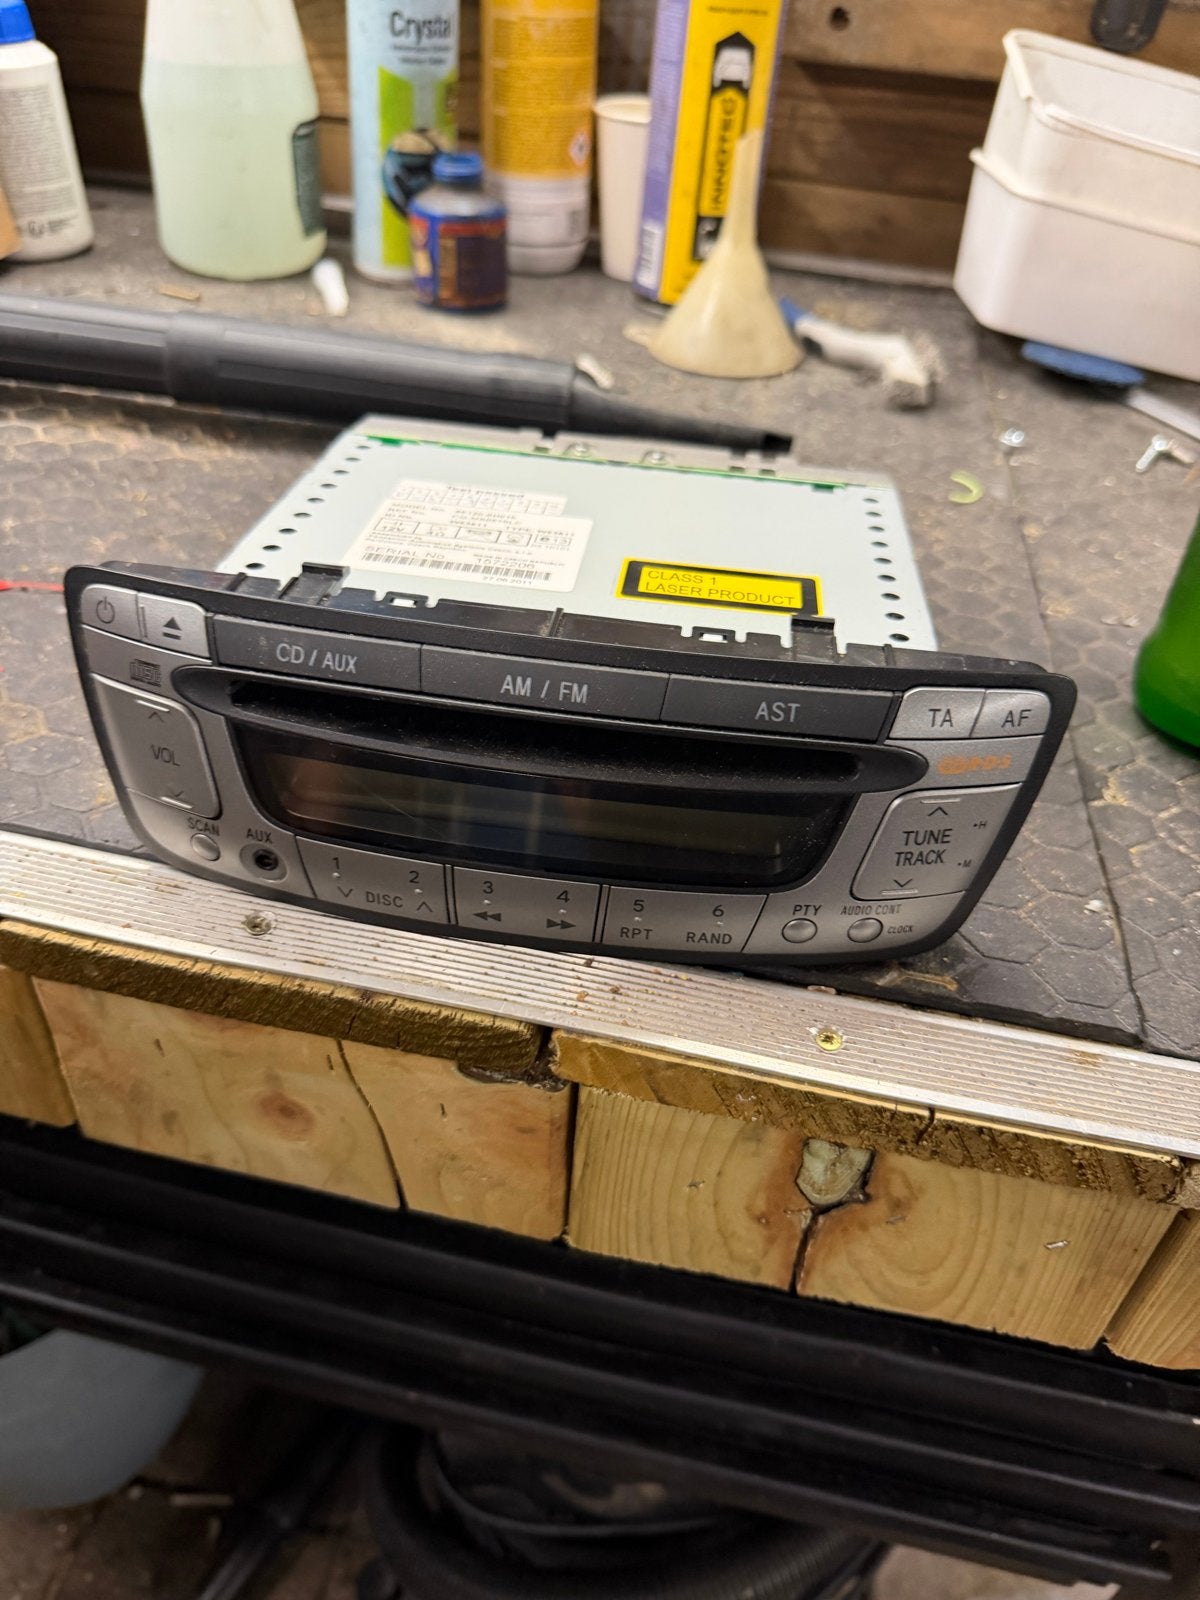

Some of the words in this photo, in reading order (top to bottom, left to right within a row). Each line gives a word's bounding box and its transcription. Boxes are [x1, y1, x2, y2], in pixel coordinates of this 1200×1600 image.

[647, 569, 704, 584] CLASS
[711, 576, 717, 586] 1
[645, 582, 702, 597] LASER
[707, 588, 796, 606] PRODUCT
[275, 643, 305, 665] CD
[321, 649, 358, 675] AUX
[500, 674, 532, 697] AM
[558, 681, 589, 704] FM
[754, 701, 801, 723] AST
[928, 708, 954, 728] TA
[1001, 708, 1032, 729] AF
[150, 743, 181, 767] VOL
[187, 816, 220, 837] SCAN
[246, 826, 274, 845] AUX
[902, 828, 953, 847] TUNE
[332, 856, 340, 870] 1
[894, 848, 947, 868] TRACK
[408, 870, 419, 884] 2
[482, 880, 494, 895] 3
[556, 889, 570, 904] 4
[365, 890, 404, 909] DISC
[632, 899, 645, 913] 5
[712, 904, 725, 918] 6
[792, 904, 822, 917] PTY
[840, 904, 872, 916] AUDIO
[874, 903, 902, 916] CONT
[619, 926, 653, 941] RPT
[685, 931, 733, 946] RAND
[887, 925, 914, 935] CLOCK
